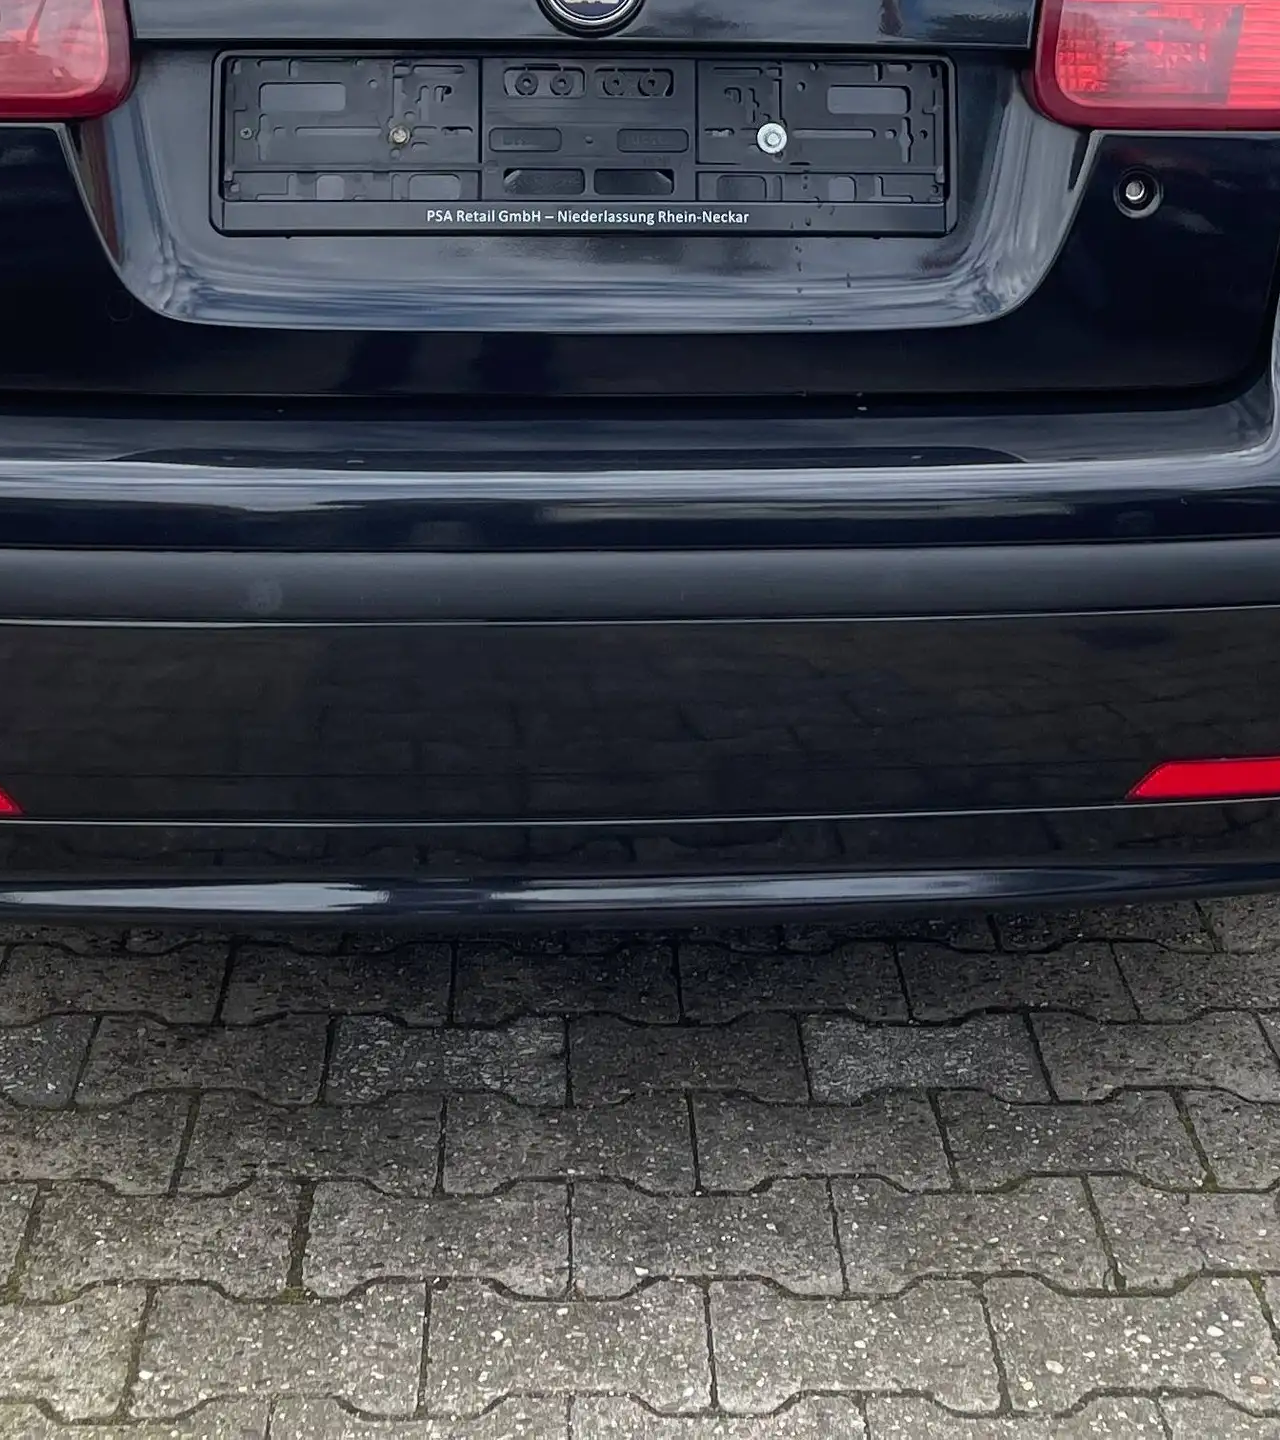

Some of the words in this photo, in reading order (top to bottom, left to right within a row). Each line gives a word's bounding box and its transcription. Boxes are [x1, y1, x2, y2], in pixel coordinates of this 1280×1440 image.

[426, 209, 453, 223] PSA
[456, 209, 495, 223] Retail
[498, 209, 541, 223] GmbH
[557, 209, 655, 226] Niederlassung
[658, 209, 749, 223] Rhein-Neckar
